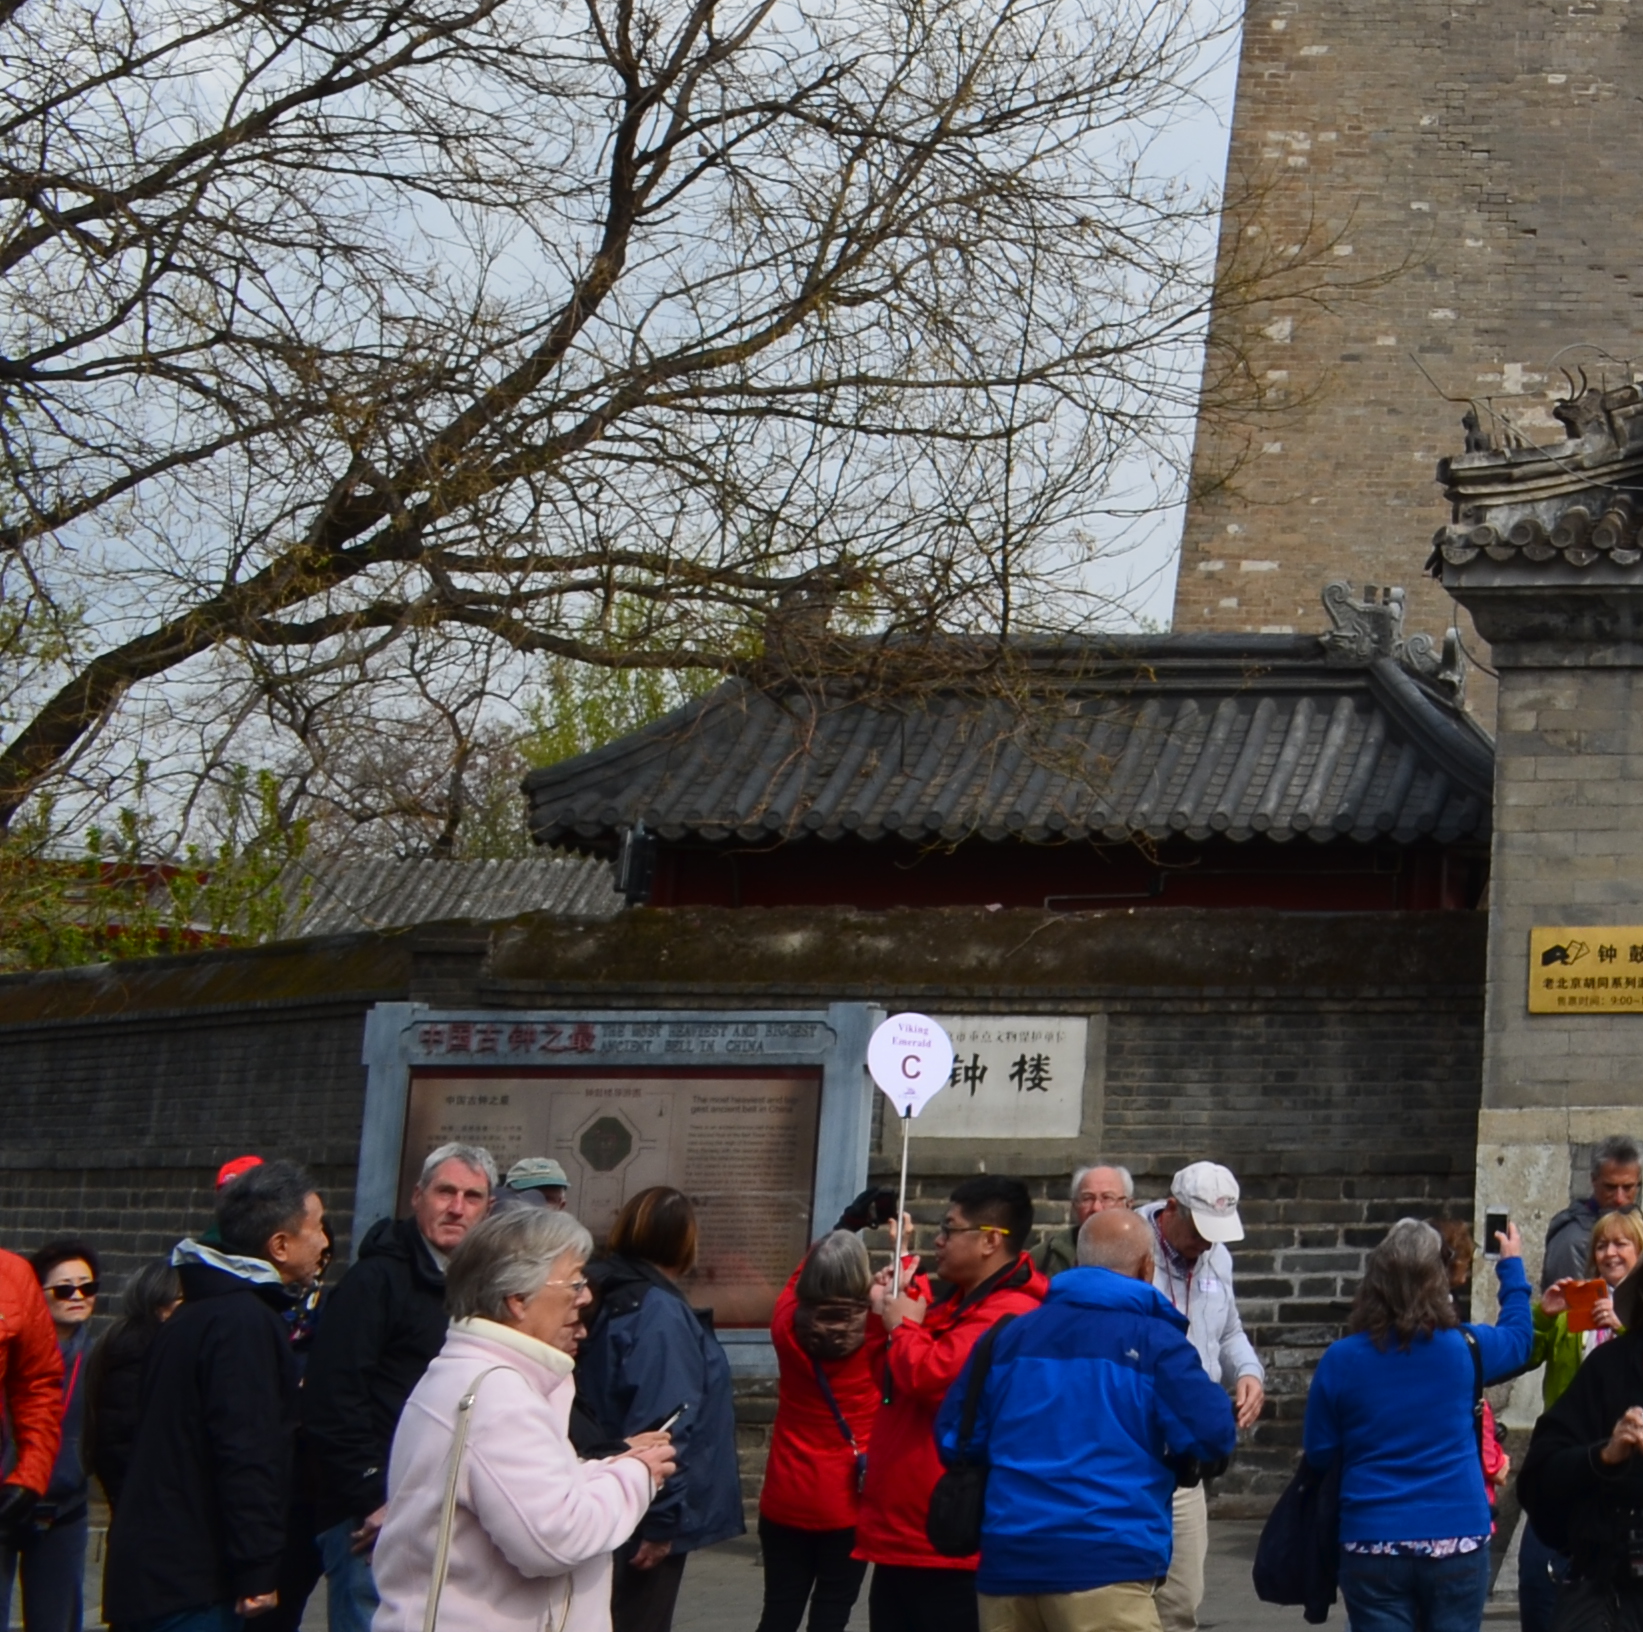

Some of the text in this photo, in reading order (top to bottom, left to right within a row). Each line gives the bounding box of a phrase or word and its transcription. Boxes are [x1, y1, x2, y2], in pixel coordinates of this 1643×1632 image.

[602, 1024, 624, 1037] THE
[632, 1024, 663, 1037] MOST
[668, 1024, 727, 1037] HEAVIEST
[732, 1024, 758, 1037] AND
[898, 1023, 929, 1035] Viking
[418, 1022, 597, 1055] 中国古钟之最
[892, 1036, 932, 1048] Emerald
[950, 1030, 1066, 1043] 市重点文物保护单位
[601, 1039, 765, 1053] ANCIENT BELL IN CHINA
[901, 1054, 922, 1079] C
[949, 1053, 1053, 1097] 钟楼
